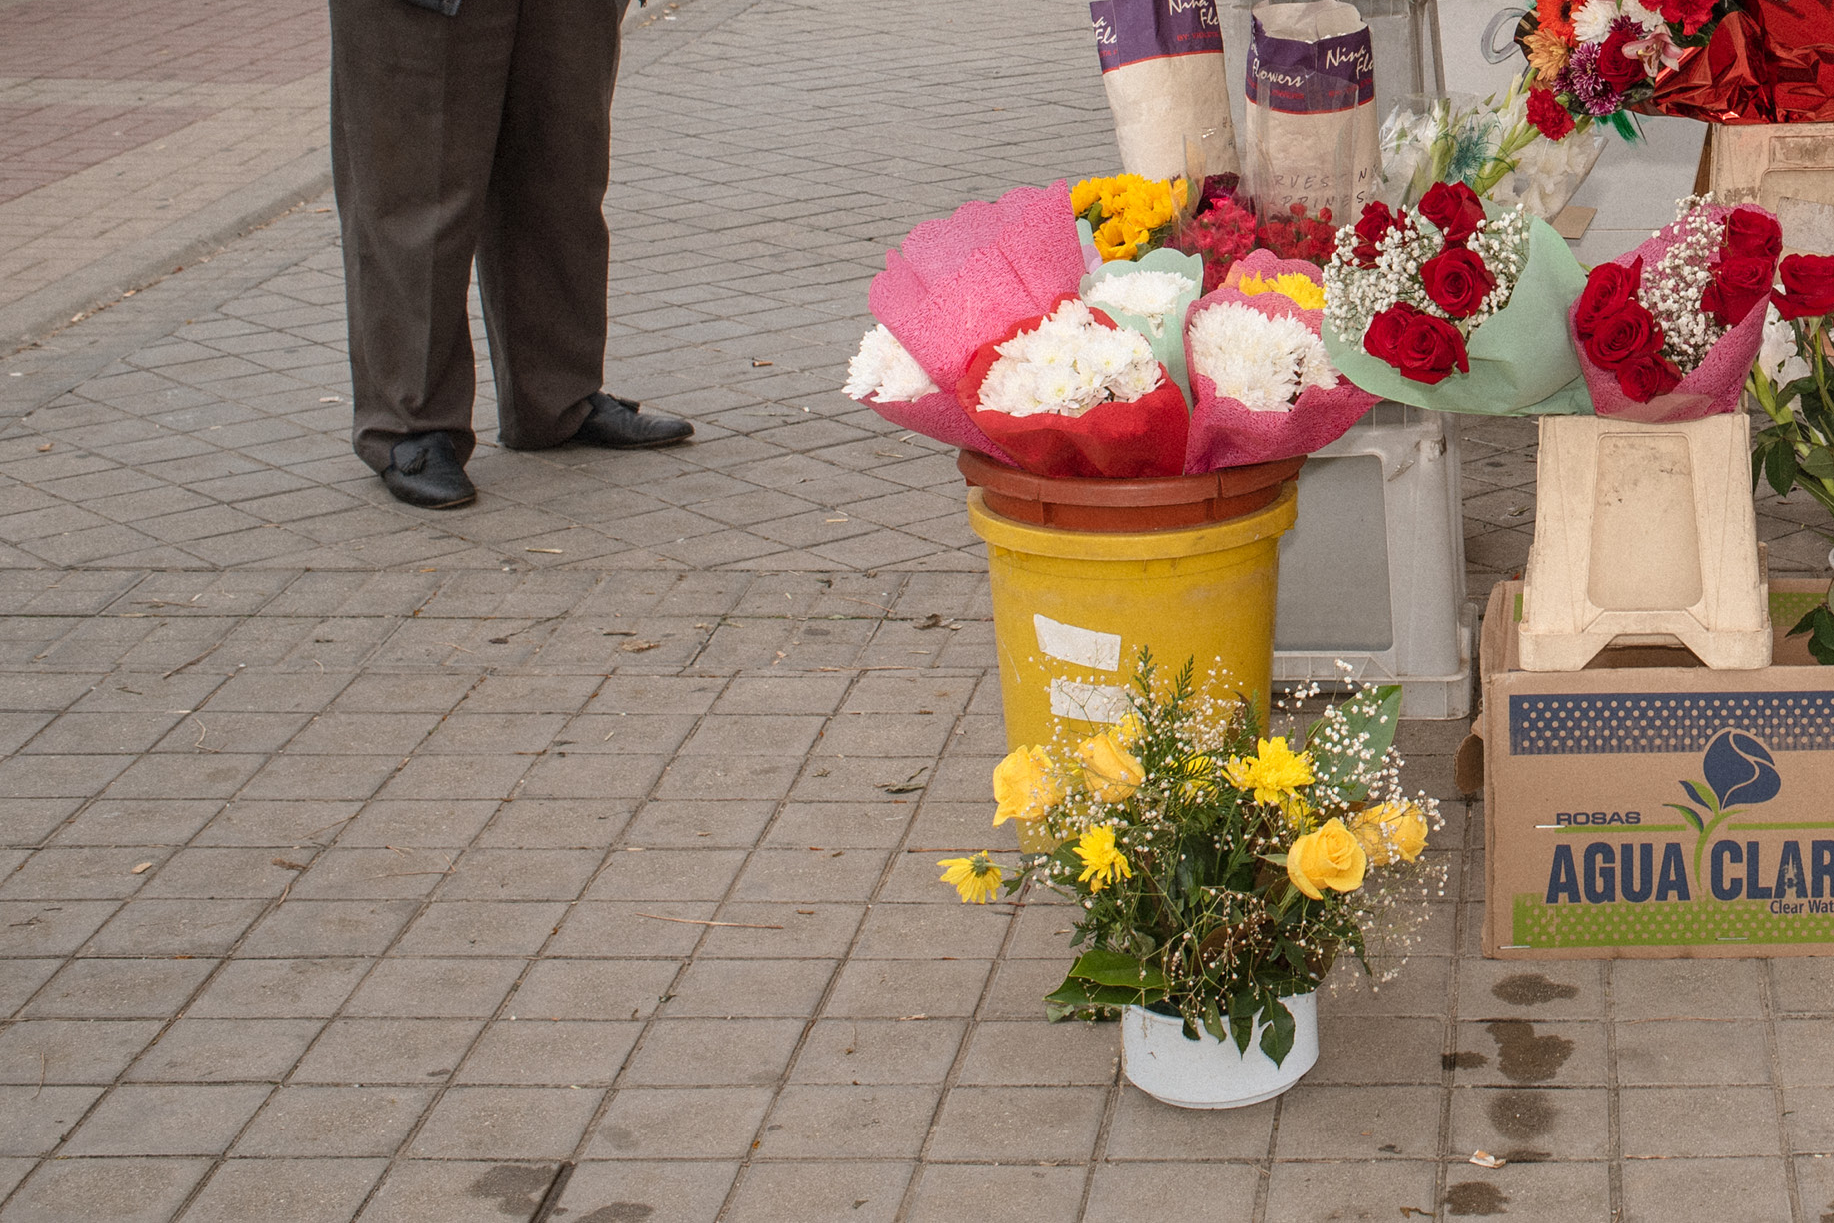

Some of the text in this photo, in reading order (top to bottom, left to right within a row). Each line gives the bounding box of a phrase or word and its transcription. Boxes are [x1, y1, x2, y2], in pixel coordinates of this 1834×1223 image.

[1556, 811, 1641, 826] ROSAS
[1546, 841, 1691, 904] AGUA
[1769, 899, 1804, 915] Clear
